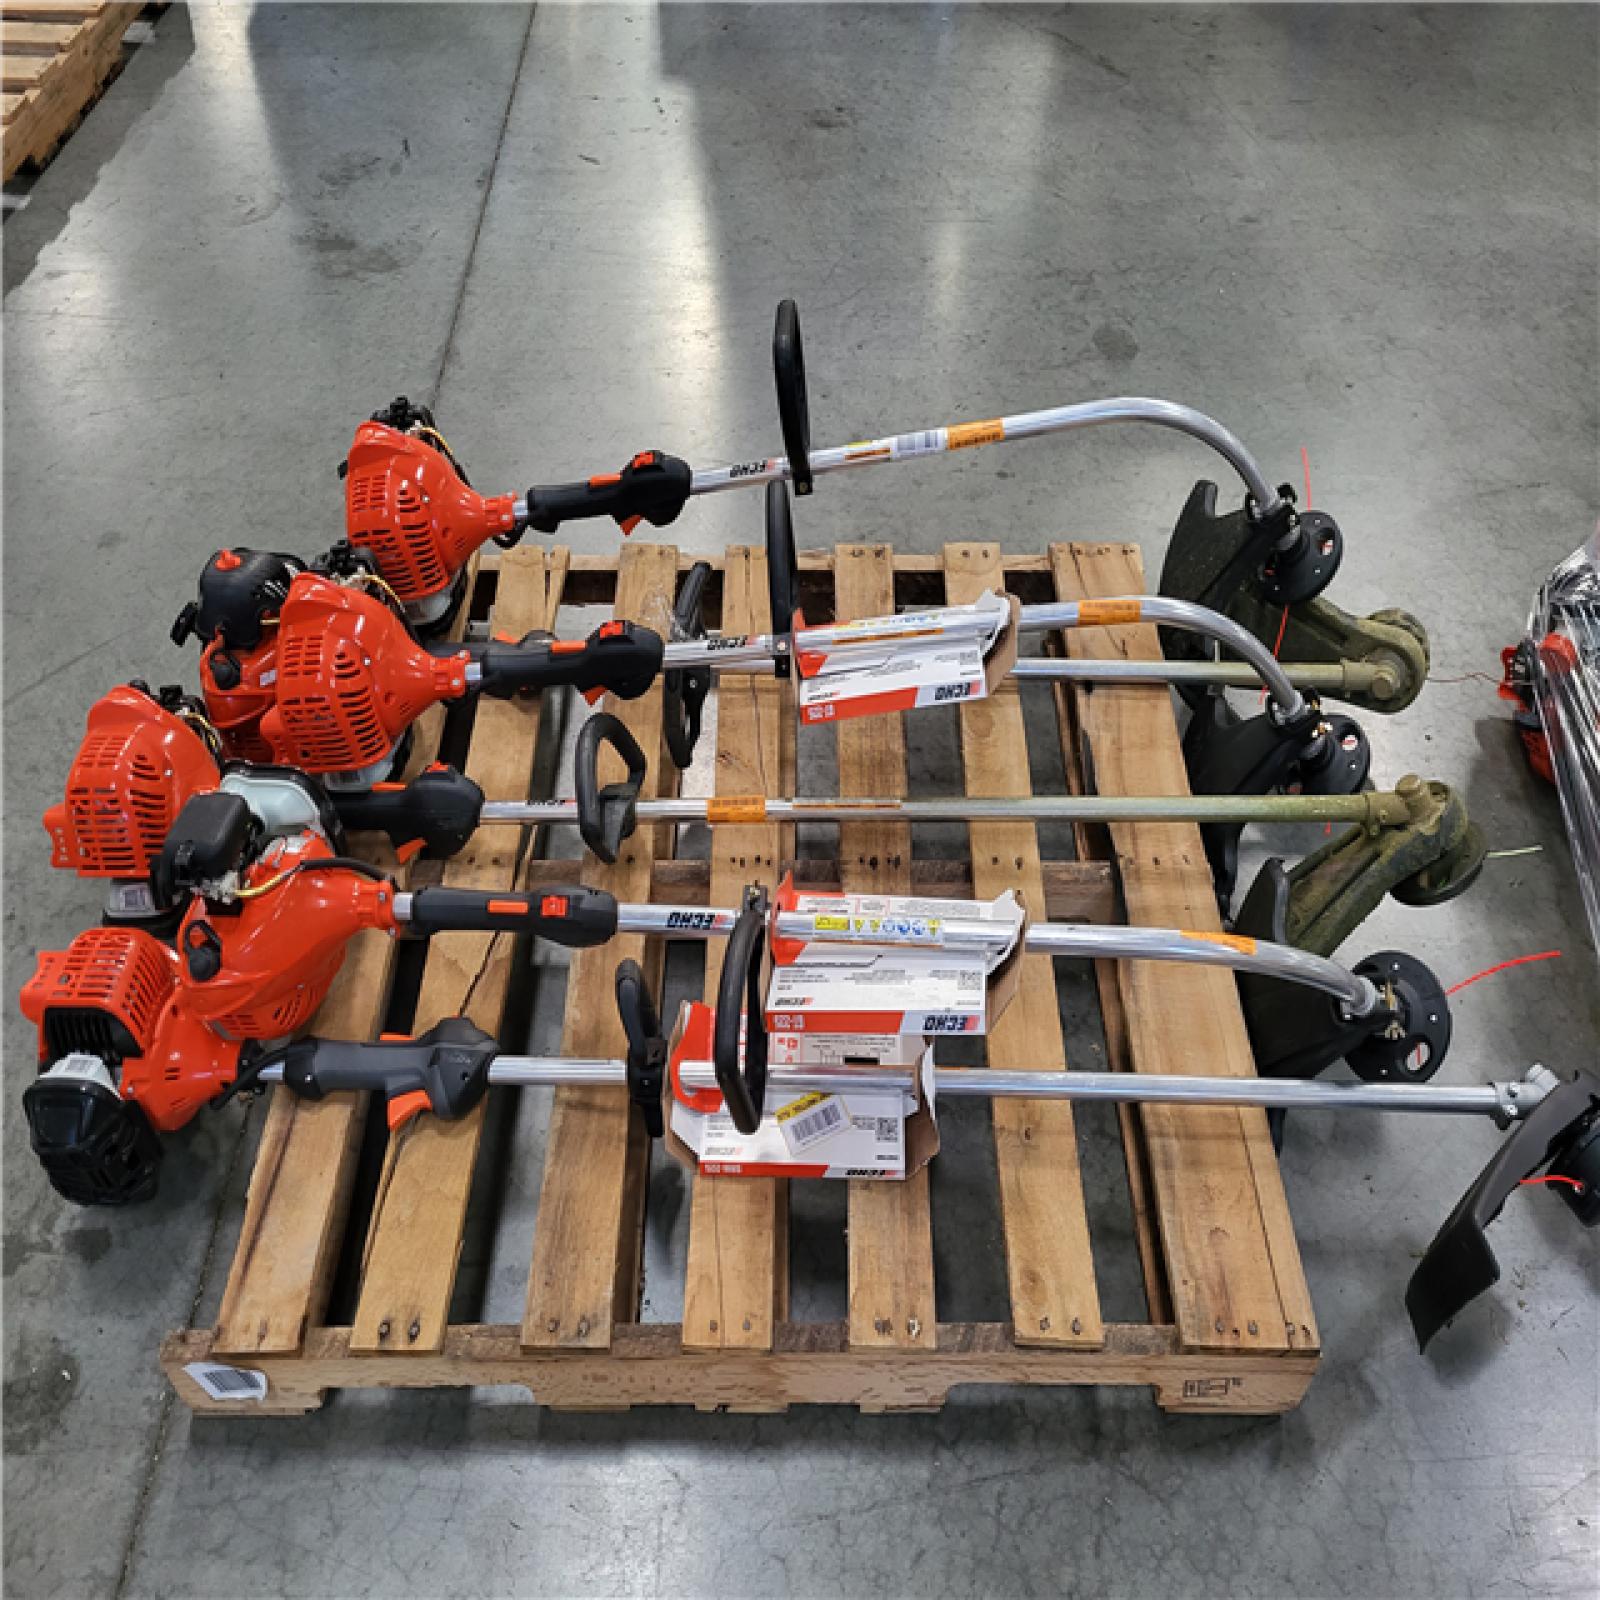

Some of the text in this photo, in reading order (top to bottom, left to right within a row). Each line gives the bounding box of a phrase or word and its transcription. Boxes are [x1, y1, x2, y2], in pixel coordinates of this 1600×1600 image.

[935, 684, 972, 701] ECHO
[666, 911, 716, 930] ECHO
[922, 1014, 969, 1032] ECHO
